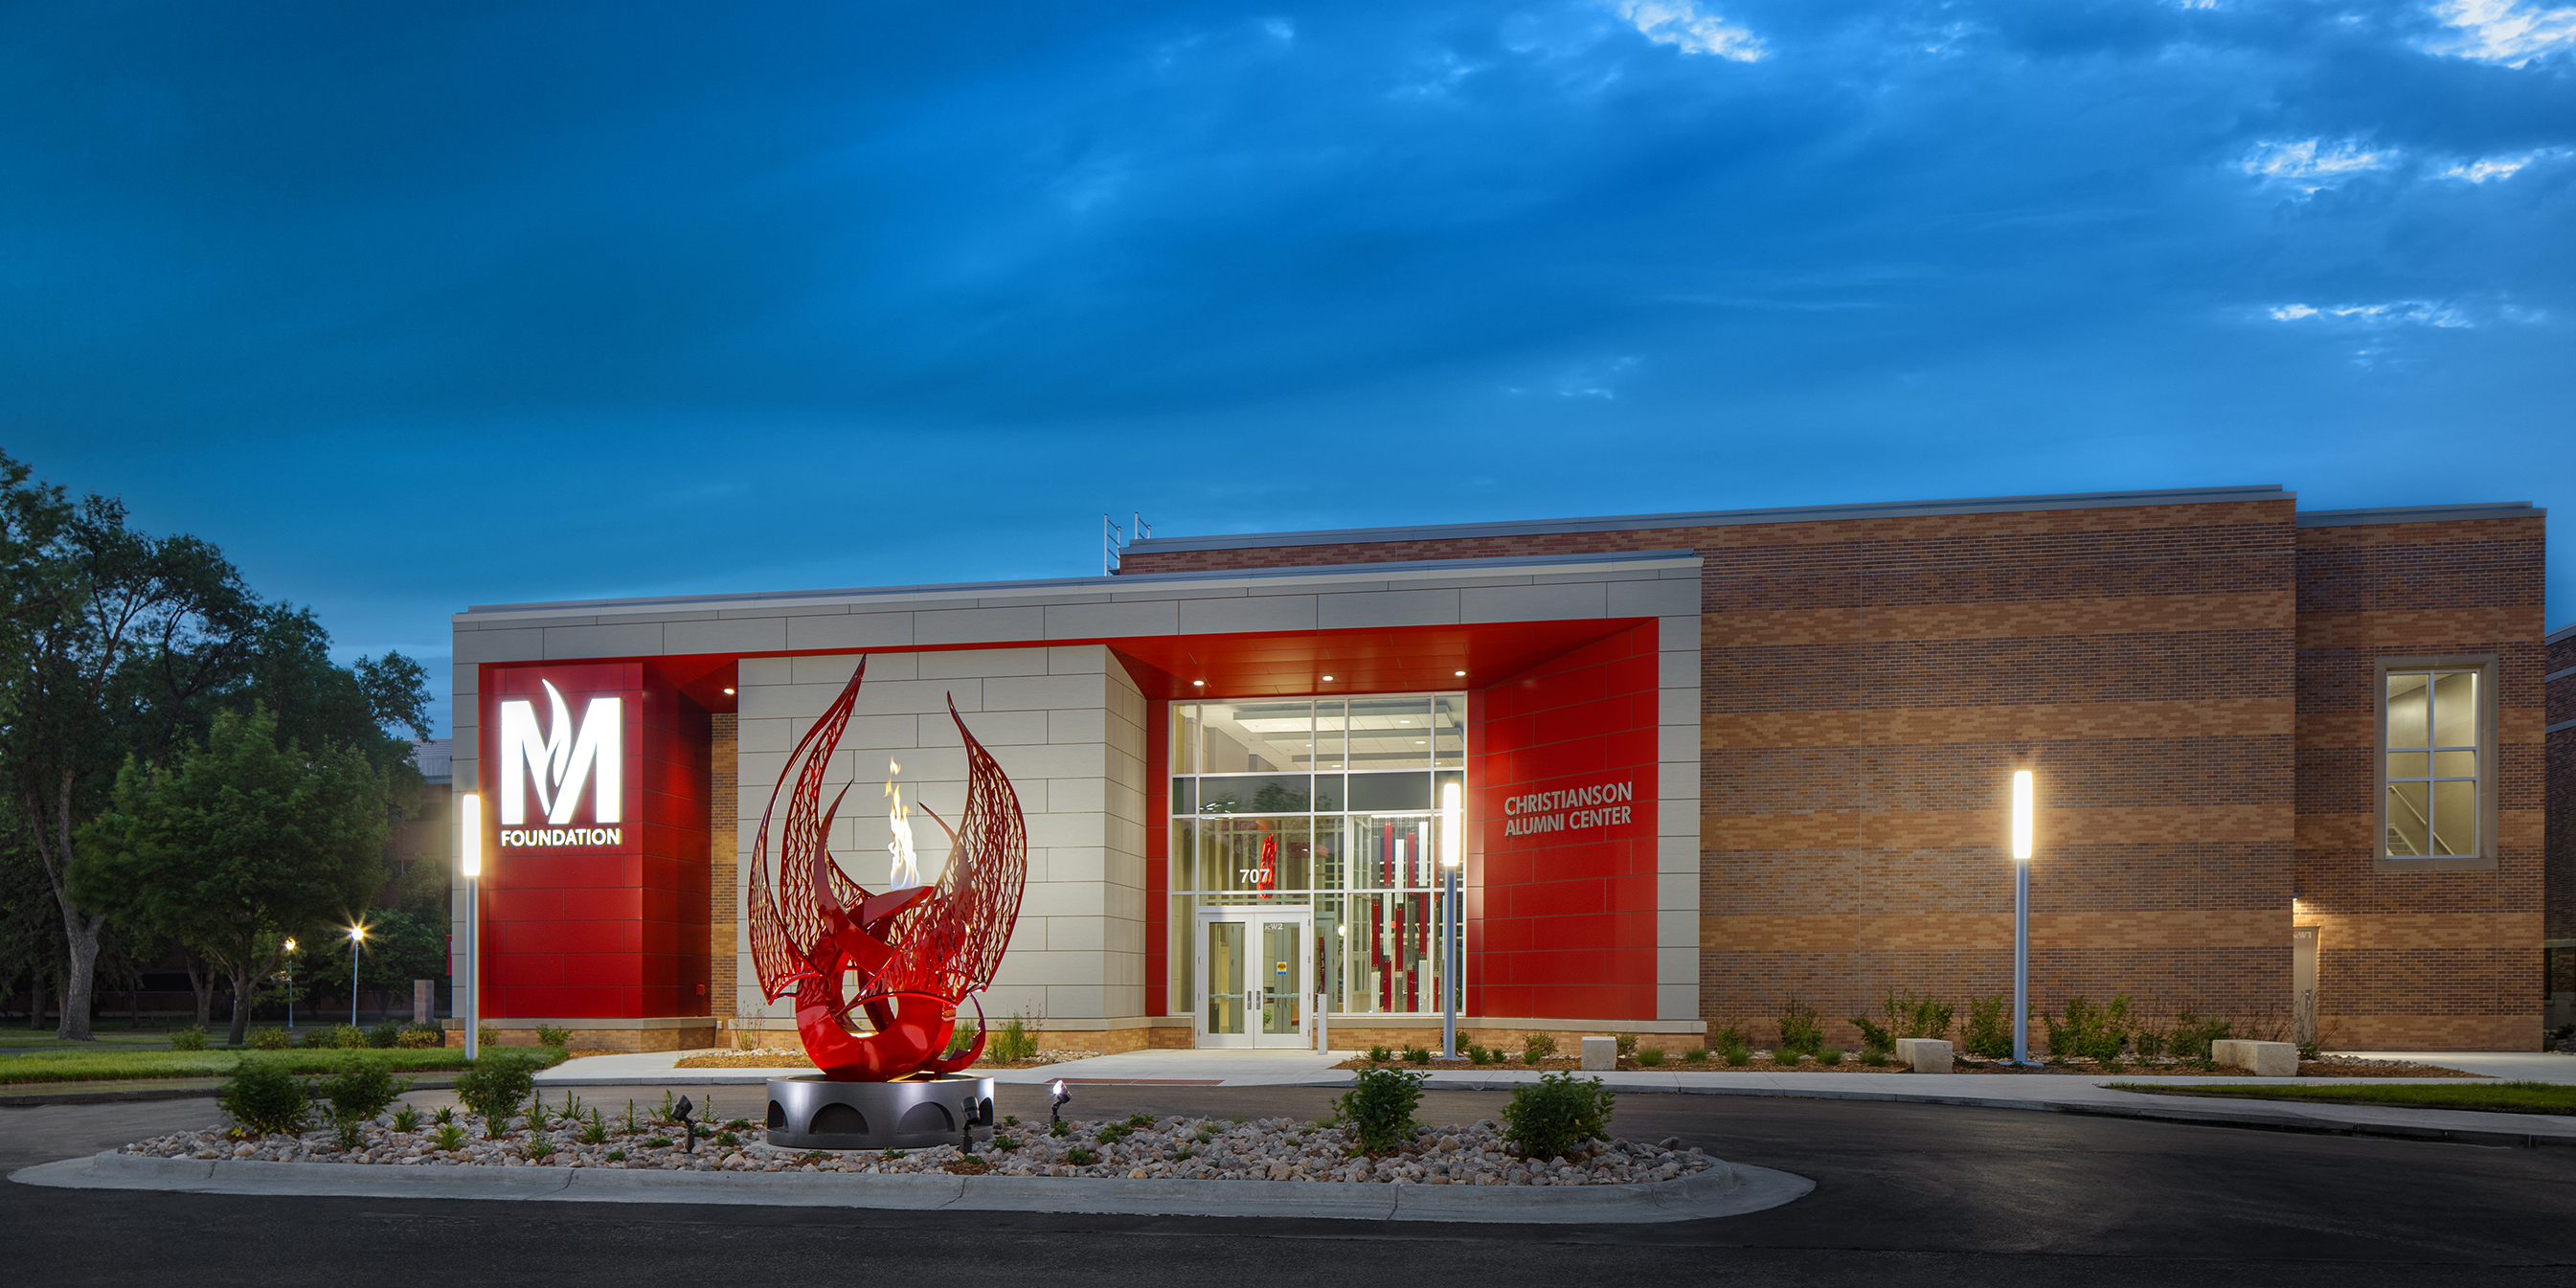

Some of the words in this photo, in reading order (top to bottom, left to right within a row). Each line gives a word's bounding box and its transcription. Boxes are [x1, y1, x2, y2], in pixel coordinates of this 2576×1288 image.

[1504, 781, 1633, 816] CHRISTIANSON
[1504, 813, 1565, 837] ALUMNI
[1569, 805, 1632, 830] CENTER
[501, 828, 621, 847] FOUNDATION
[1239, 869, 1270, 884] 707
